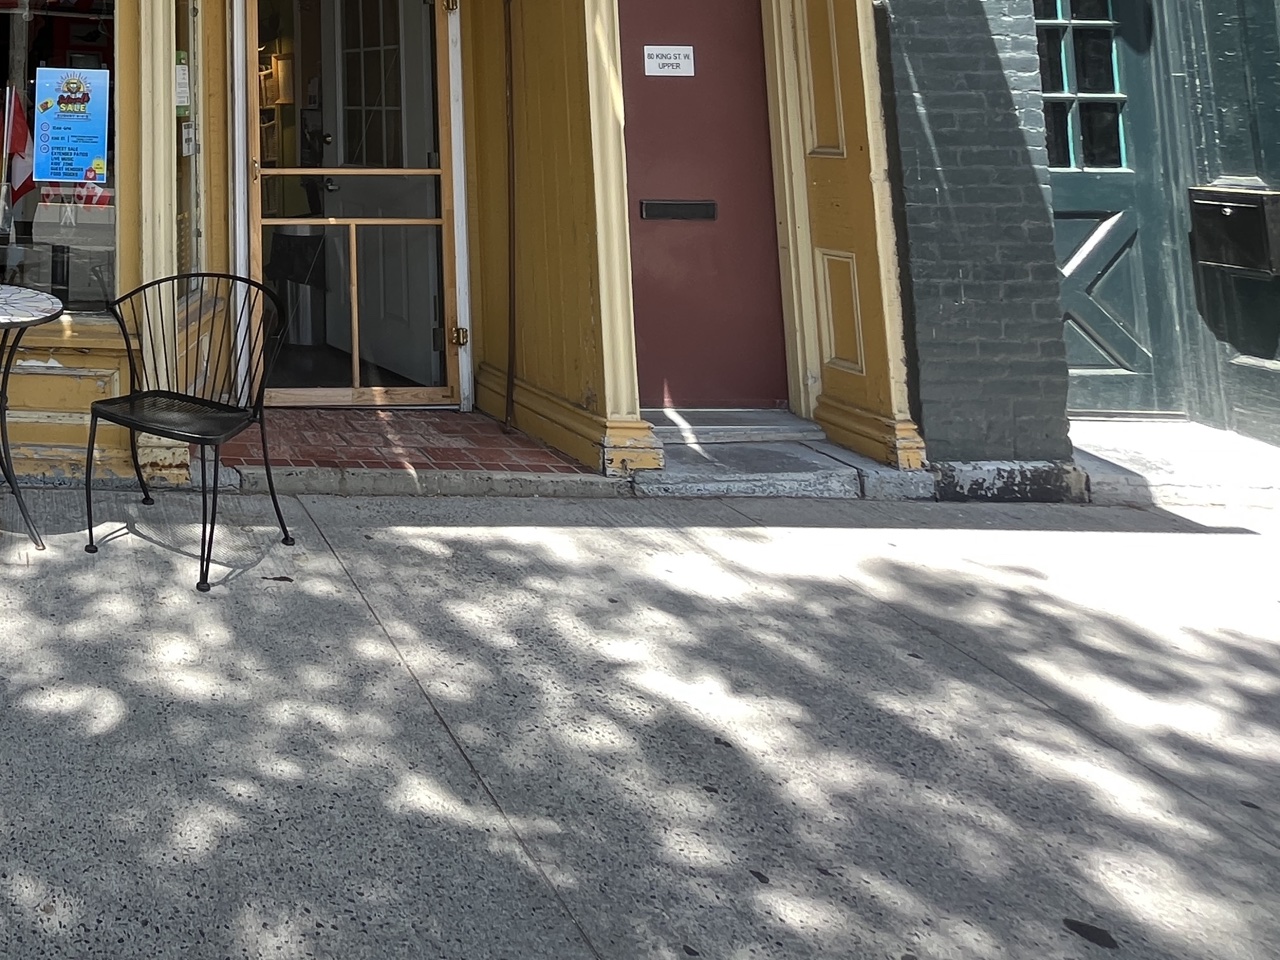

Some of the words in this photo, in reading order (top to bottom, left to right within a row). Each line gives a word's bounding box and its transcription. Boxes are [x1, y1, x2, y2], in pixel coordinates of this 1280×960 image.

[655, 52, 672, 60] KING
[658, 62, 681, 70] UPPER
[60, 103, 86, 112] SALE
